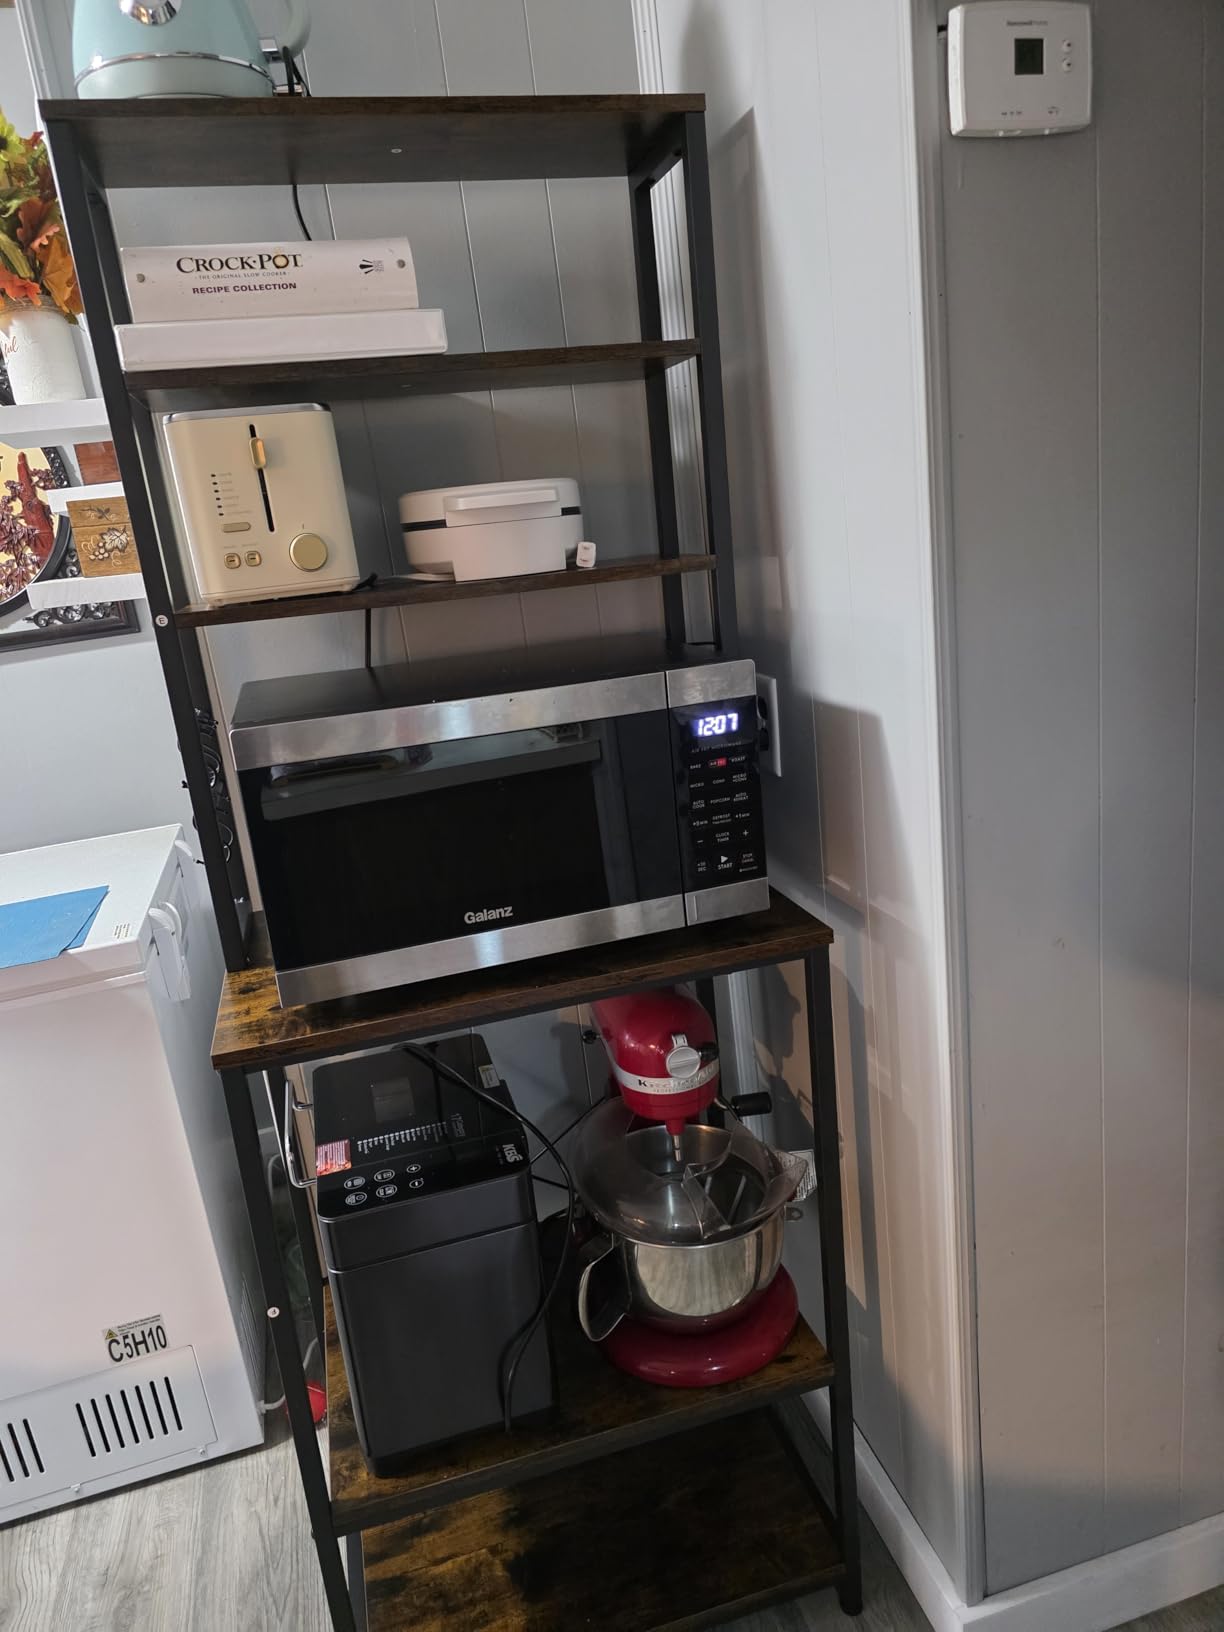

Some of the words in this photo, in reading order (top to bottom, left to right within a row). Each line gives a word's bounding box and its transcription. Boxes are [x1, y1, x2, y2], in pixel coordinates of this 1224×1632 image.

[192, 286, 230, 294] RECIPE
[233, 283, 297, 292] COLLECTION
[464, 906, 513, 924] Galanz
[108, 1325, 167, 1363] C5H10
